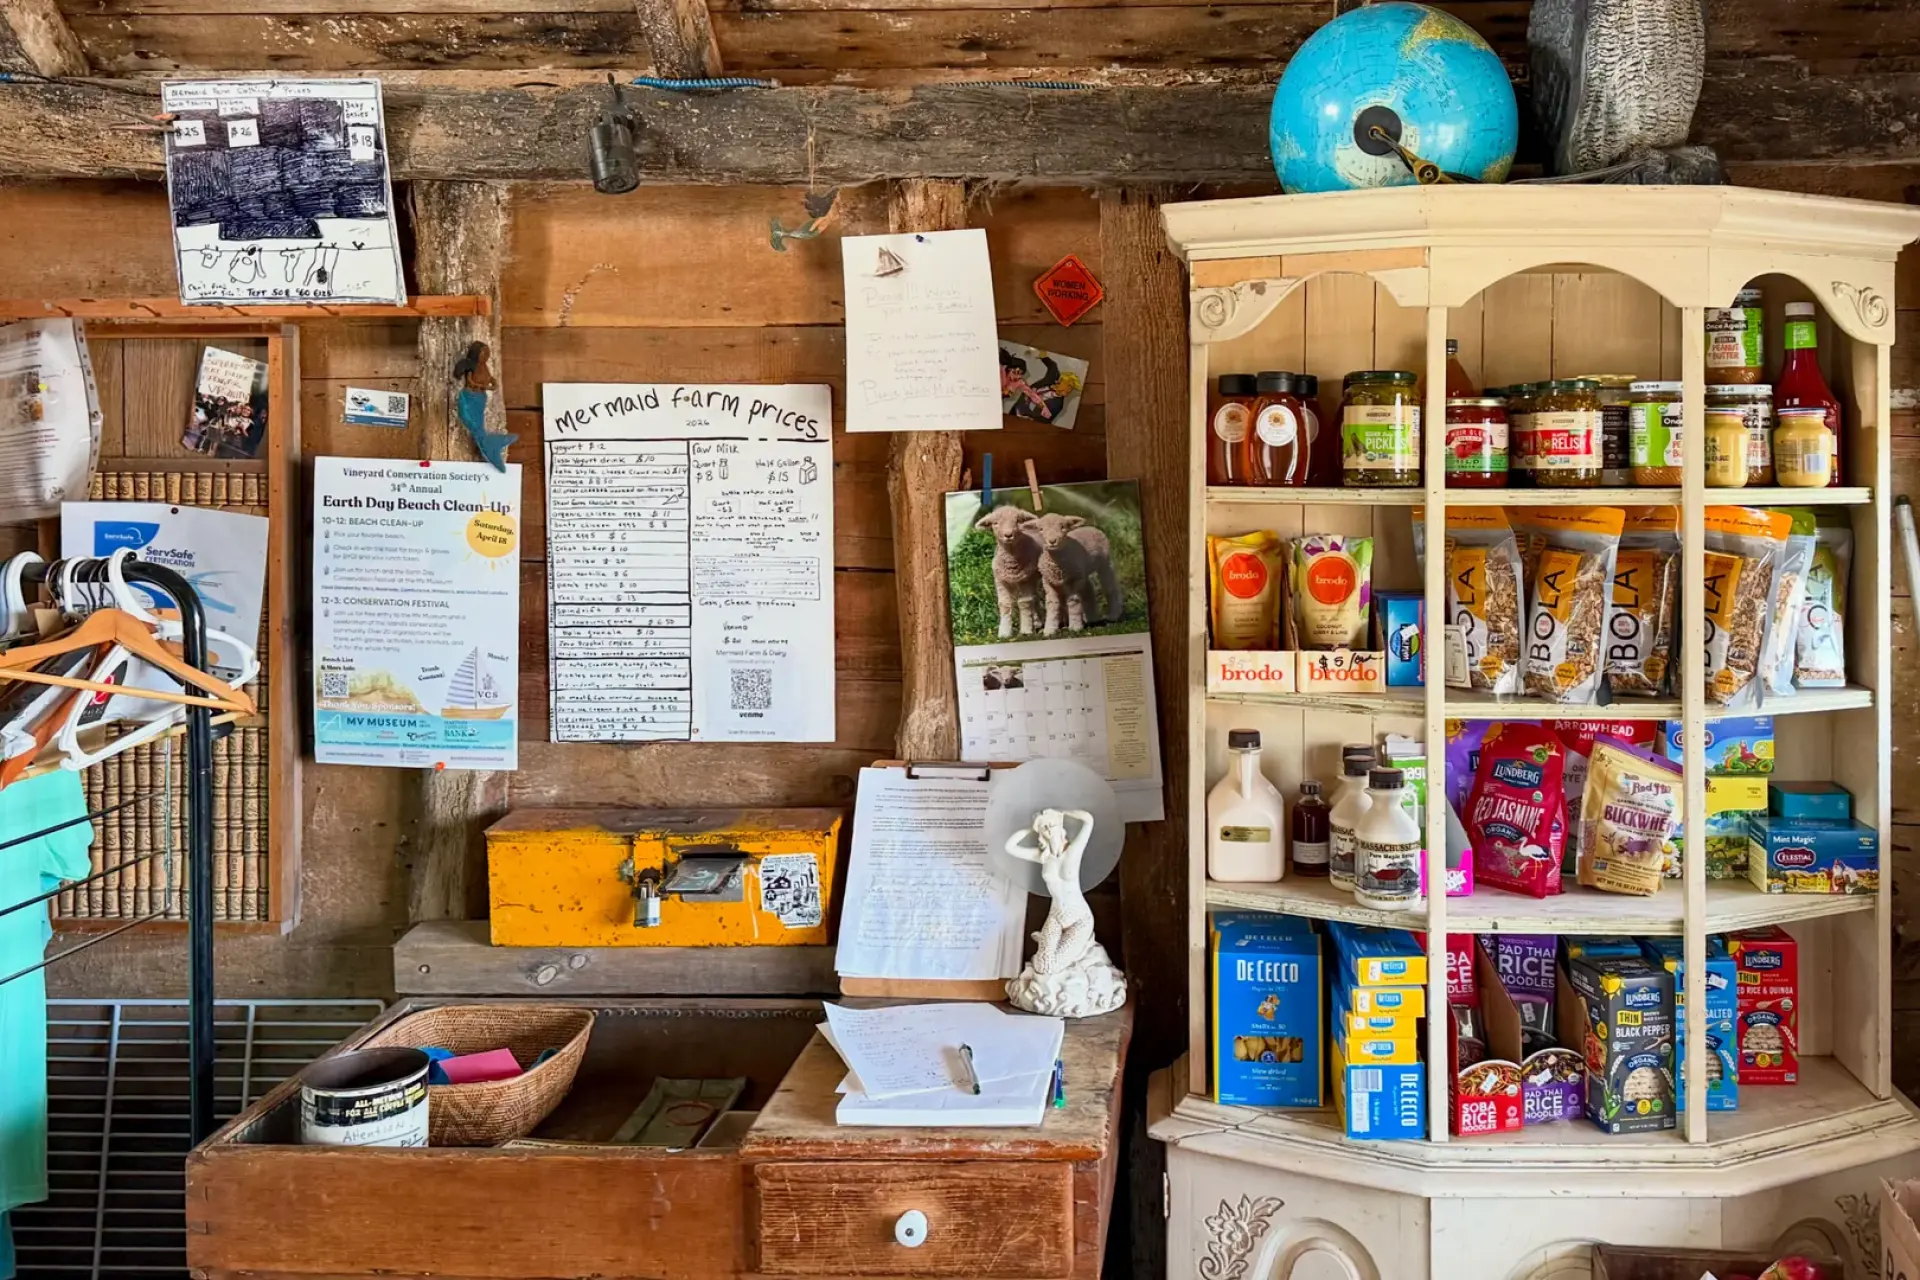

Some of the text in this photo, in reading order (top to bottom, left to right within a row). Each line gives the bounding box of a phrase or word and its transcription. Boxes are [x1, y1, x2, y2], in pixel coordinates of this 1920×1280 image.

[1053, 280, 1086, 289] WOMEN
[1048, 289, 1088, 301] WORKING
[1724, 322, 1746, 330] Again
[1712, 344, 1739, 352] PEANUT
[686, 419, 710, 427] 2026
[747, 399, 819, 438] prices
[554, 443, 583, 454] yogurt
[717, 443, 739, 453] Milk
[1366, 436, 1406, 449] PICKLS
[1552, 437, 1585, 449] RELISH
[692, 460, 716, 468] Quart
[343, 468, 489, 483] Vineyard Conservation Society's
[409, 484, 442, 494] Annual
[323, 495, 510, 515] Earth Day Beach Clean-Up
[322, 516, 424, 527] 10-12: BEACH CLEAN-UP
[474, 519, 514, 535] Saturday,
[476, 532, 497, 544] April
[146, 546, 194, 560] ServSafe
[144, 556, 195, 568] CERTIFICATION
[1229, 570, 1259, 580] brodo
[1315, 575, 1348, 586] brodo
[320, 596, 449, 608] 12-3: CONSERVATION FESTIVAL
[1529, 569, 1566, 662] BOLA
[1610, 568, 1639, 660] BOLA
[1221, 664, 1283, 681] brodo
[1309, 662, 1377, 681] brodo
[477, 691, 498, 699] VCS
[347, 717, 364, 726] MV
[367, 717, 417, 728] MUSEUM
[1554, 721, 1634, 736] ARROWHEAD
[1494, 764, 1540, 784] LUNDBERG
[1632, 782, 1652, 795] Red
[1473, 796, 1545, 839] RED JASMINE
[1486, 827, 1518, 840] ORGANIC
[1773, 836, 1815, 845] Mint Magic
[1778, 851, 1812, 862] CELESTIAL
[1499, 944, 1555, 958] PAD THAI
[1499, 954, 1555, 977] RICE
[1744, 955, 1781, 967] LUNDBERG
[1237, 960, 1299, 983] DE CECCO
[1738, 972, 1758, 983] THIN
[1500, 975, 1555, 988] NOODLES
[1447, 984, 1474, 994] DLES
[1737, 986, 1794, 995] ED RICE & QUINOA
[1625, 992, 1660, 1005] LUNDBERG
[1619, 1012, 1640, 1023] THIN
[1706, 1008, 1732, 1019] SALTED
[1747, 1015, 1779, 1024] ORGANIC
[1616, 1024, 1670, 1038] BLACK PEPPER
[1628, 1057, 1659, 1068] ORGANIC
[1544, 1088, 1563, 1096] THAI
[1401, 1090, 1418, 1127] CECCO
[1462, 1101, 1496, 1114] SOBA
[1525, 1096, 1562, 1112] RICE
[346, 1109, 360, 1117] FOR
[1462, 1112, 1496, 1126] RICE
[1524, 1109, 1563, 1120] NOODLES
[1462, 1122, 1497, 1132] NOODLES
